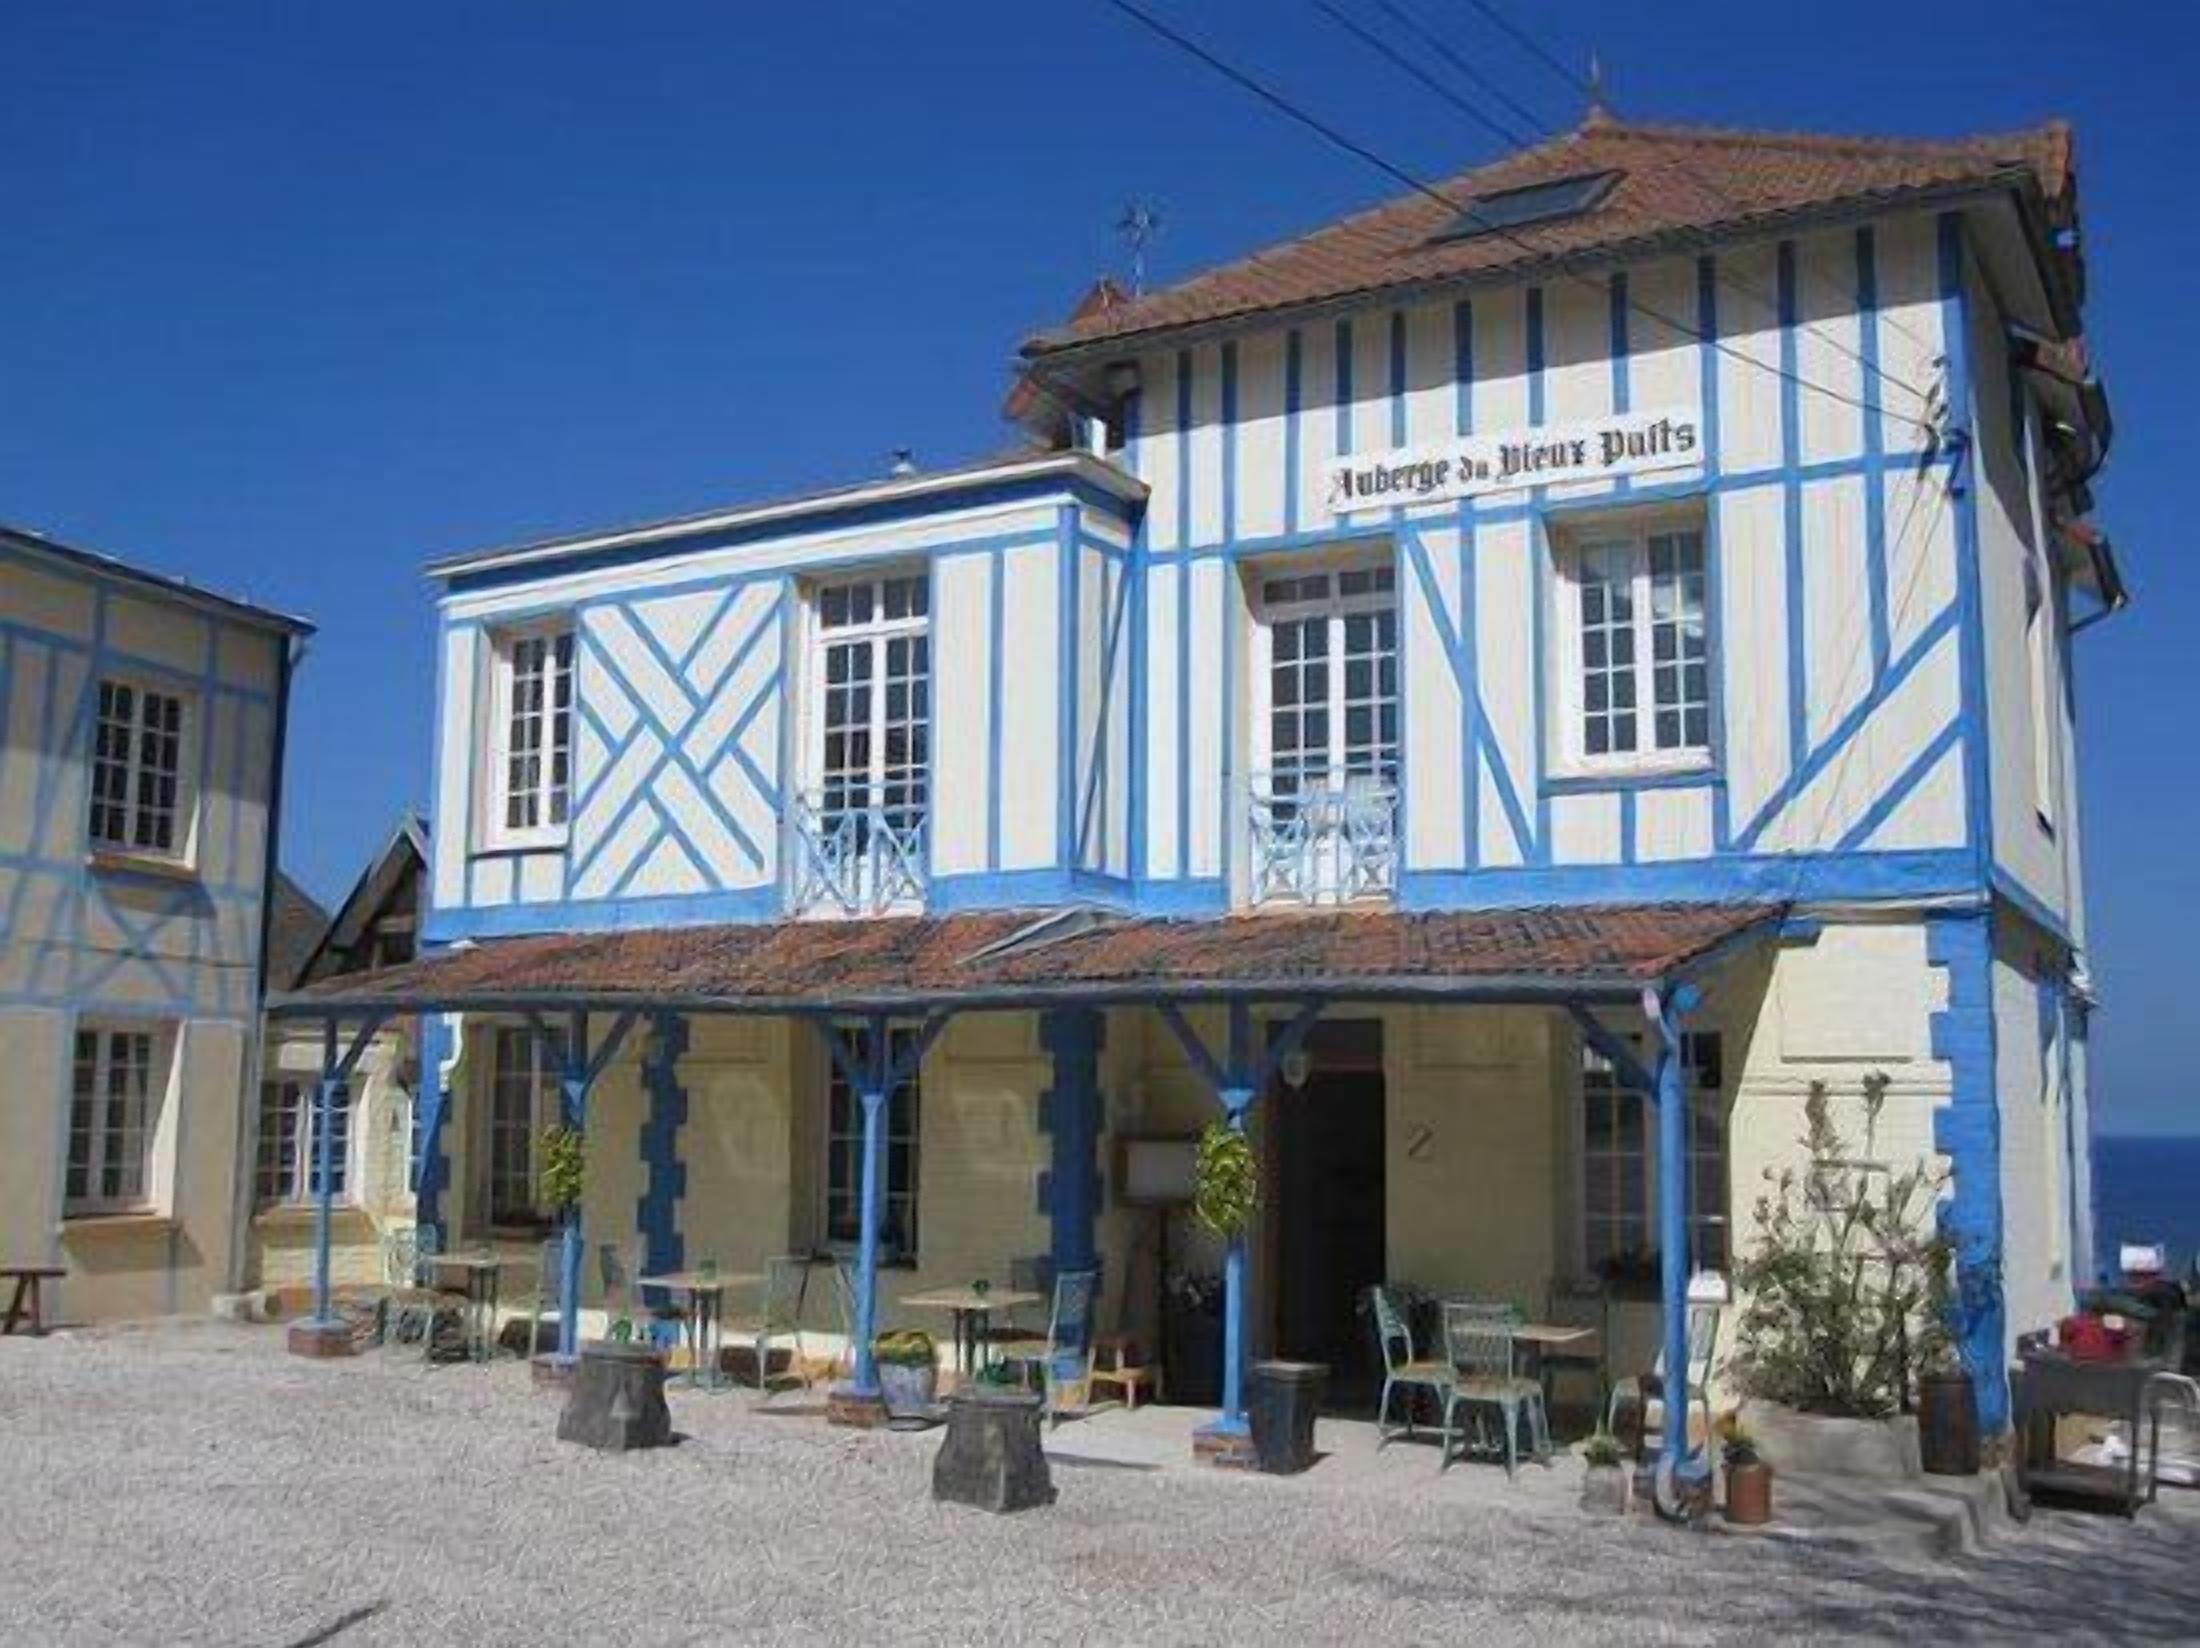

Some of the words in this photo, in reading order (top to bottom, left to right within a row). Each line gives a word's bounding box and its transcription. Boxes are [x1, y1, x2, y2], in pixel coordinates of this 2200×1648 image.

[1328, 457, 1450, 504] Auberge
[1458, 455, 1489, 482] du
[1497, 438, 1586, 480] Vieux
[1598, 417, 1696, 468] Puits
